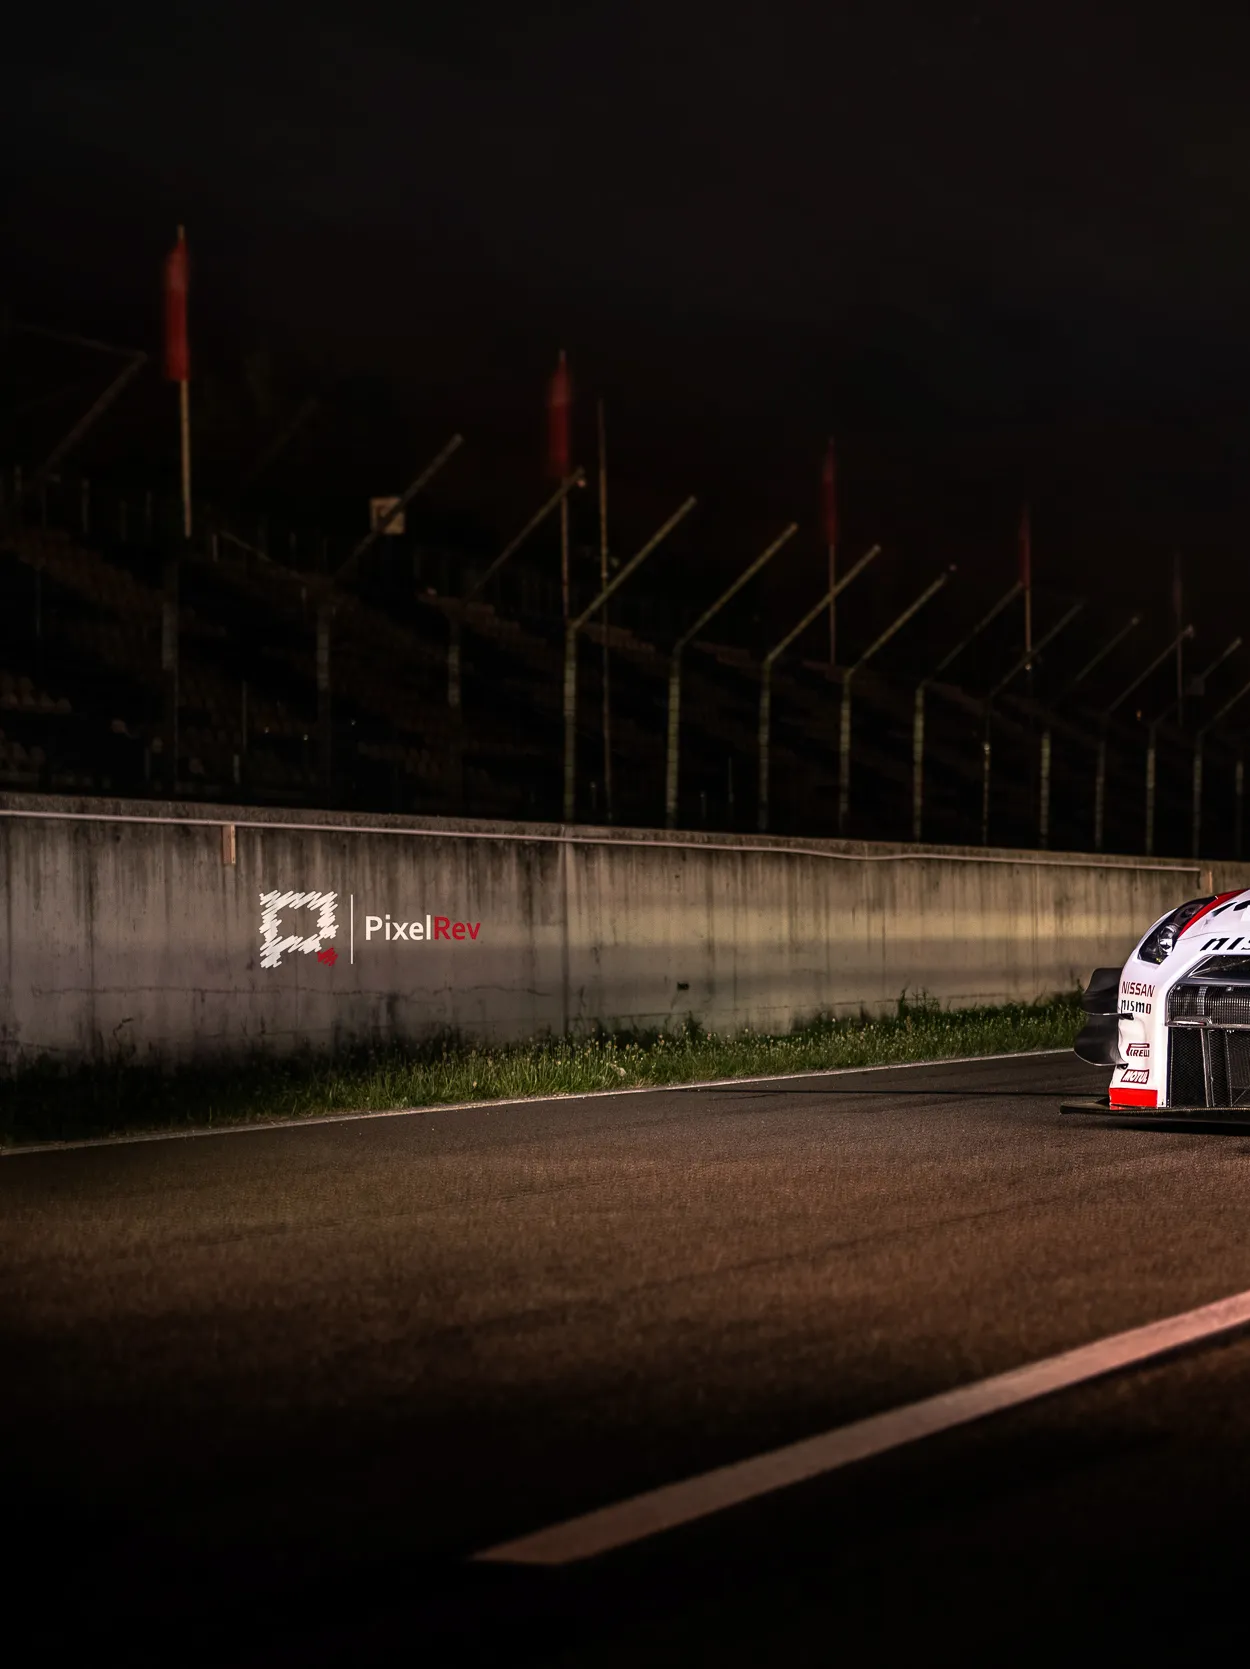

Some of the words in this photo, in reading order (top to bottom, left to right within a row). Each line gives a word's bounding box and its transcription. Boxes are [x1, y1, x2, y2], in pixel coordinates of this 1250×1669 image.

[1121, 981, 1155, 998] NISSAN
[1121, 999, 1152, 1014] nismo
[1122, 1070, 1149, 1084] MOTUL
